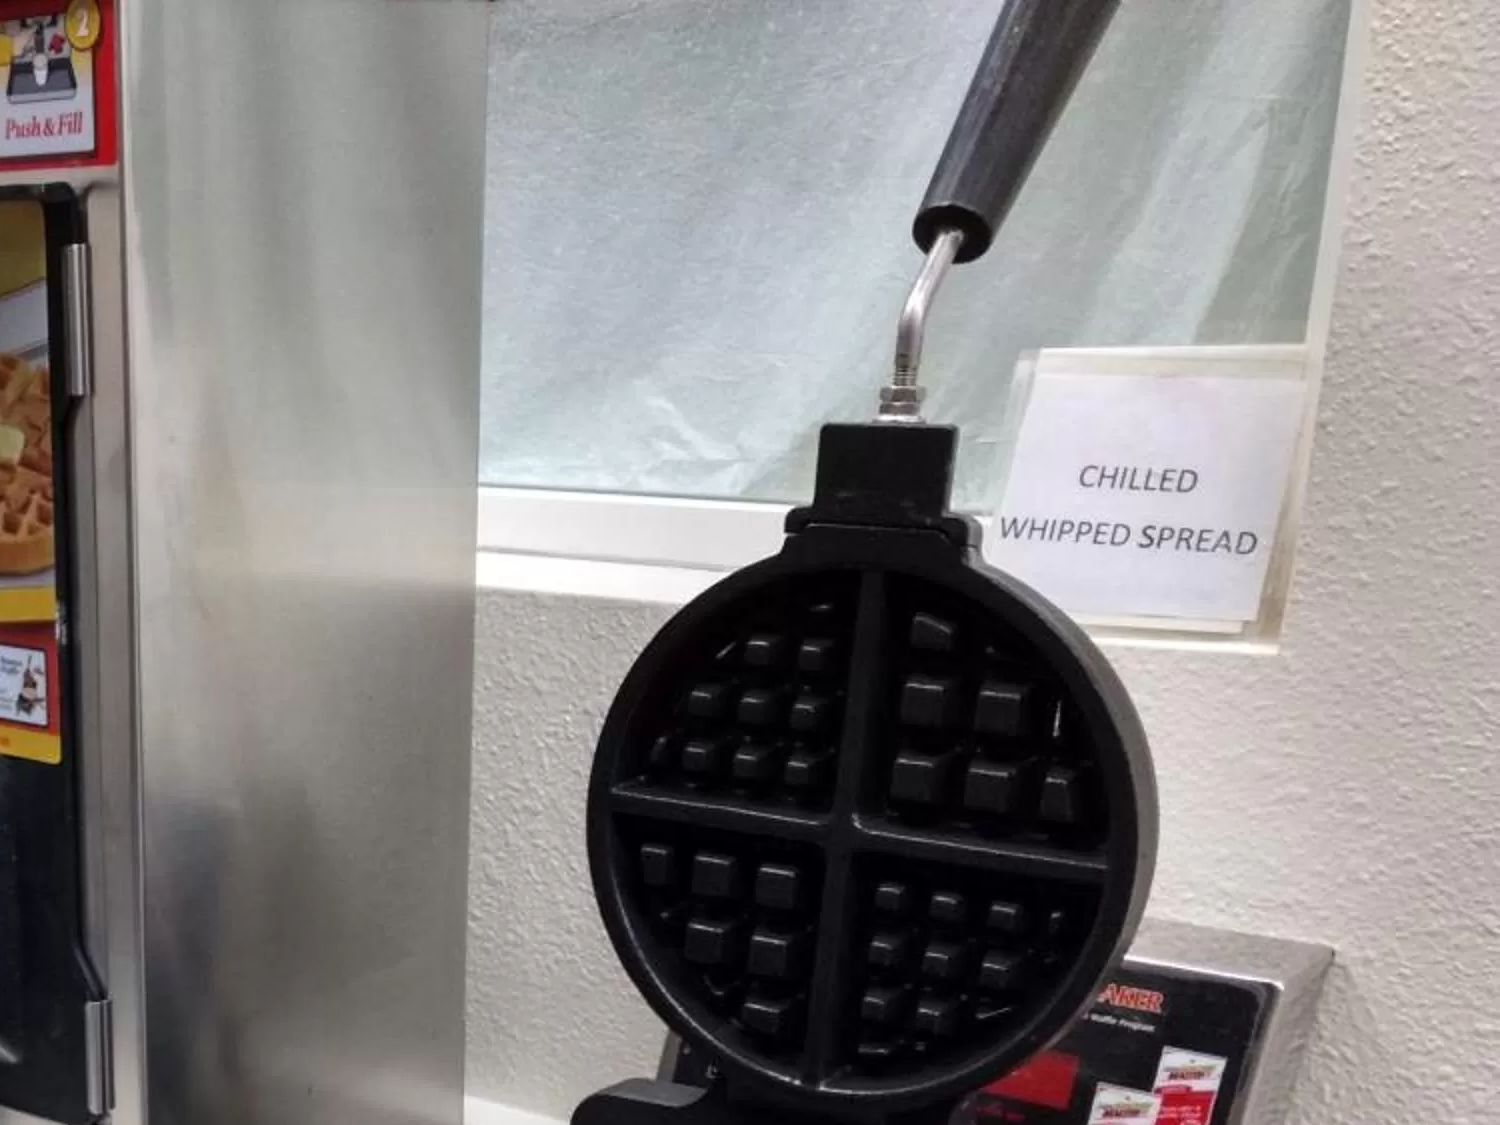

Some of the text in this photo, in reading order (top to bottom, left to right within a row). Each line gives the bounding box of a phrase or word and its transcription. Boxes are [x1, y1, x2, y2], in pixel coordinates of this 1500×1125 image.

[76, 10, 91, 37] 2
[5, 116, 41, 140] Push
[57, 111, 83, 136] Fill
[1078, 465, 1199, 493] CHILLED
[1000, 516, 1258, 555] WHIPPED SPREAD
